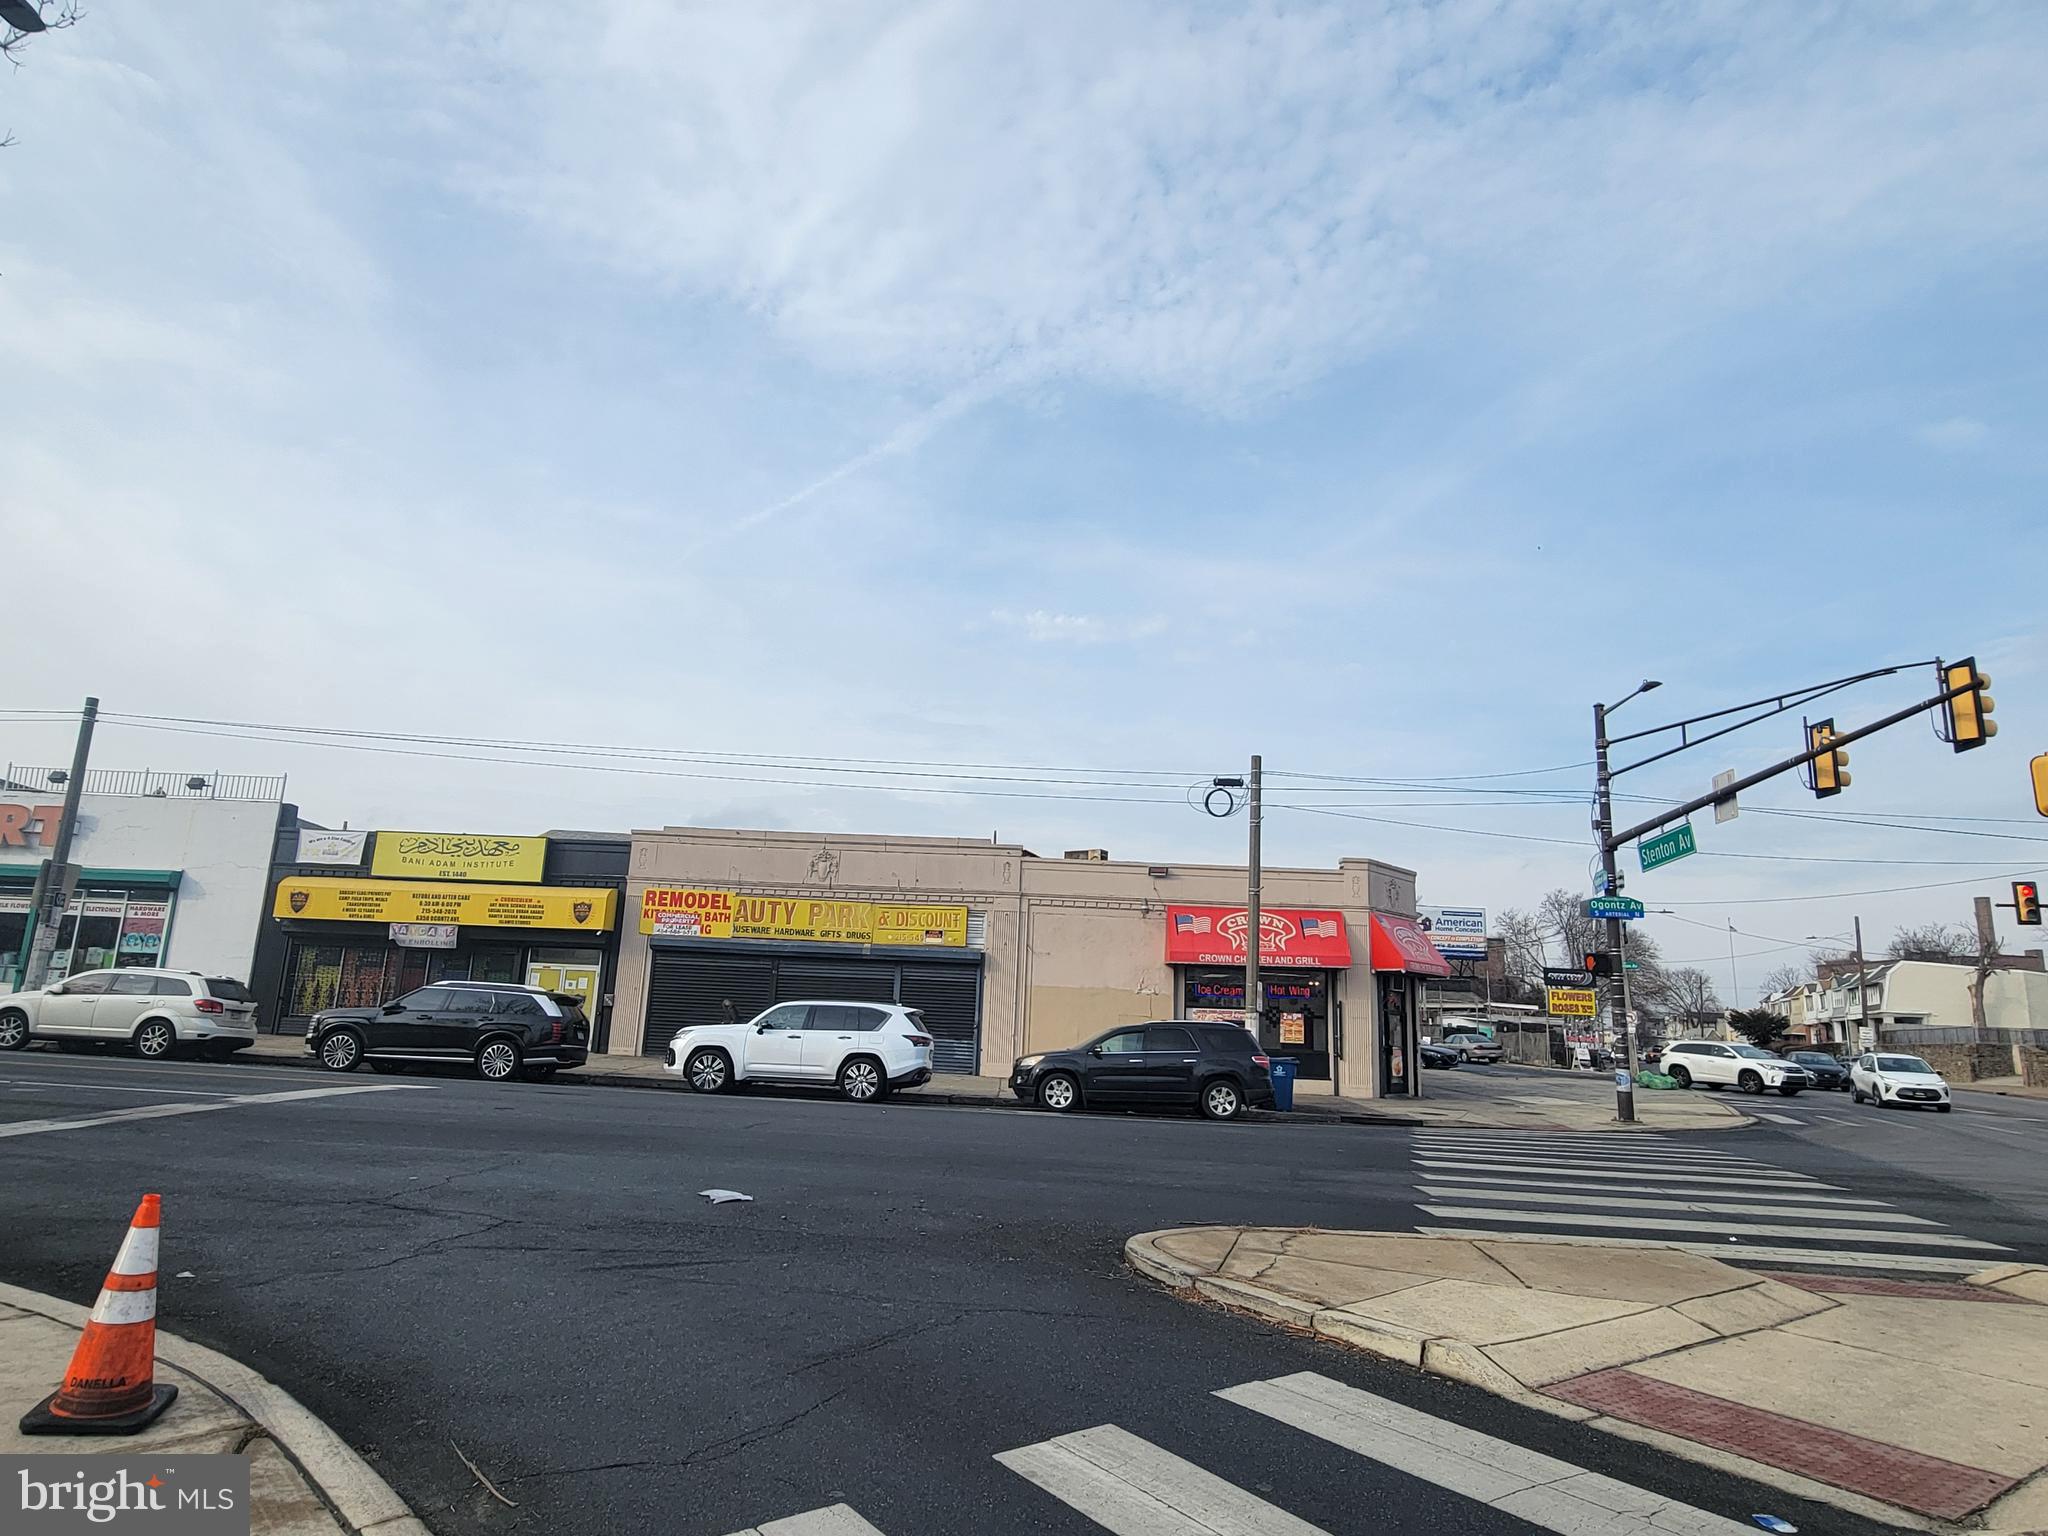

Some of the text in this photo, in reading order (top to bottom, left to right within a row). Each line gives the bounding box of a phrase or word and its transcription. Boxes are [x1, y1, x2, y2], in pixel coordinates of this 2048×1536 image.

[1641, 833, 1691, 865] Stenton Av
[401, 856, 515, 869] BANI ADAM INSTITUTE
[644, 890, 732, 911] REMODEL
[1590, 900, 1642, 911] Ogontz Av
[704, 911, 731, 923] BATH
[896, 911, 961, 928] DISCOUNT
[1226, 916, 1285, 929] CRWN
[1435, 917, 1483, 928] American
[774, 927, 815, 937] HARDWARE
[820, 930, 842, 938] GIFTS
[846, 931, 871, 940] DRUGS
[1199, 953, 1232, 963] CROWN
[1274, 955, 1293, 964] AND
[1295, 956, 1321, 965] GRILL
[1198, 984, 1243, 996] Ice Cream
[1270, 984, 1311, 999] Hot Wing
[1551, 991, 1593, 1002] FLOWERS
[1552, 1003, 1579, 1012] ROSES
[70, 1377, 127, 1389] DANELLA
